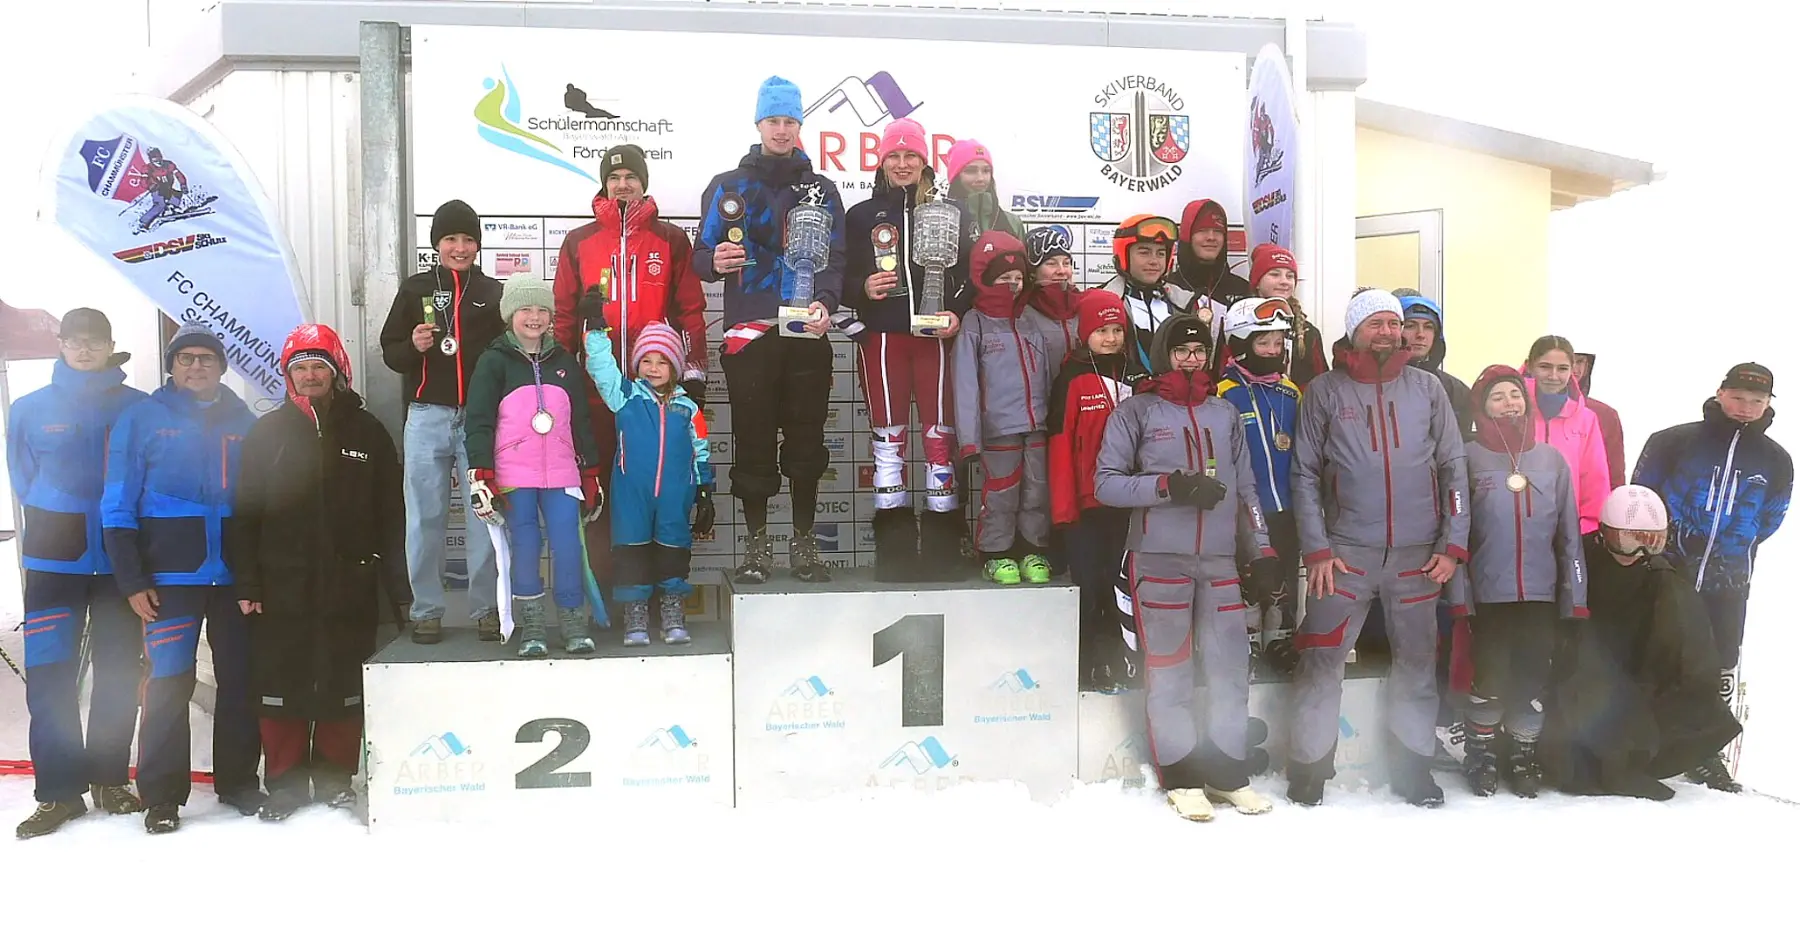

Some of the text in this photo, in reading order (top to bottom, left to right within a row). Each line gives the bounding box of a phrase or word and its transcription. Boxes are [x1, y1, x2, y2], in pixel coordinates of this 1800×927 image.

[1094, 75, 1184, 111] SKIVERBAND
[528, 116, 674, 135] Schülermannschaft
[92, 146, 110, 169] FC
[573, 146, 672, 160] Fördrein
[795, 131, 957, 172] RBR
[101, 137, 133, 197] CHAMMÜNSTER
[1100, 163, 1182, 192] BAYERWALD
[842, 181, 855, 189] IM
[860, 182, 876, 190] BA
[153, 235, 196, 259] DSV
[166, 270, 194, 294] FC
[226, 343, 282, 396] INLINE
[710, 441, 728, 453] EC
[446, 536, 466, 546] EIS
[873, 614, 944, 727] 1
[765, 720, 845, 731] Bayerischer Wald
[1029, 713, 1051, 721] Wald
[515, 717, 591, 789] 2
[393, 782, 486, 796] Bayerischer Wald
[685, 774, 711, 783] Wald
